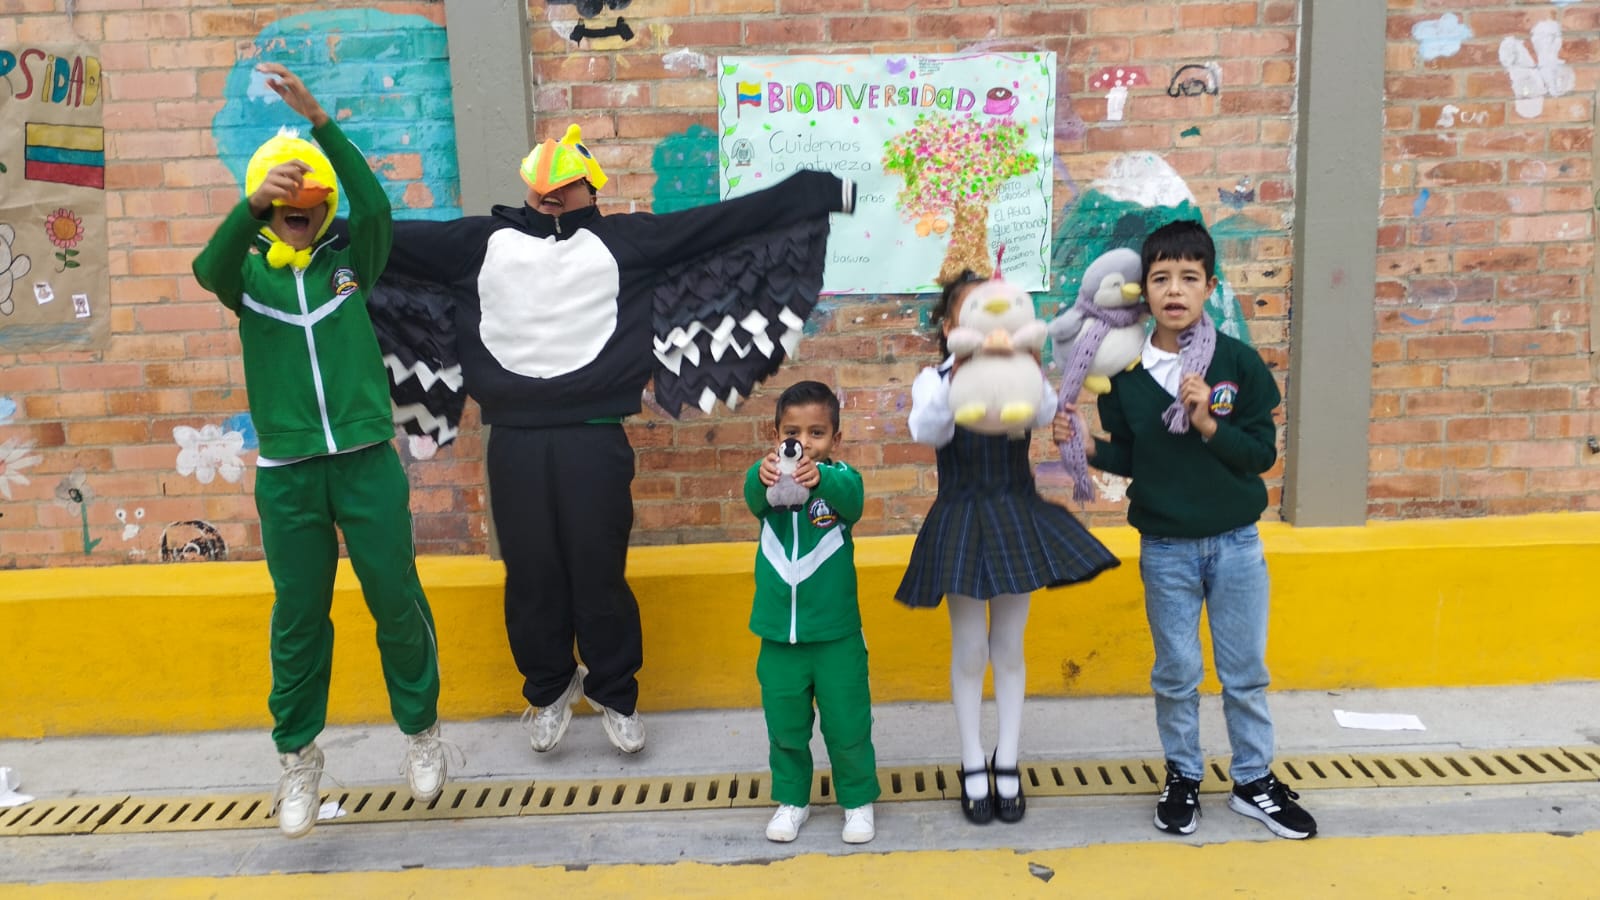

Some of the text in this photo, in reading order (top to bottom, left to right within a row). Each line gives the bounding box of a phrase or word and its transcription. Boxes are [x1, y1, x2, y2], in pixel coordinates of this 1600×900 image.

[769, 130, 861, 154] Cuidemos
[770, 157, 785, 172] la
[833, 249, 871, 264] basura
